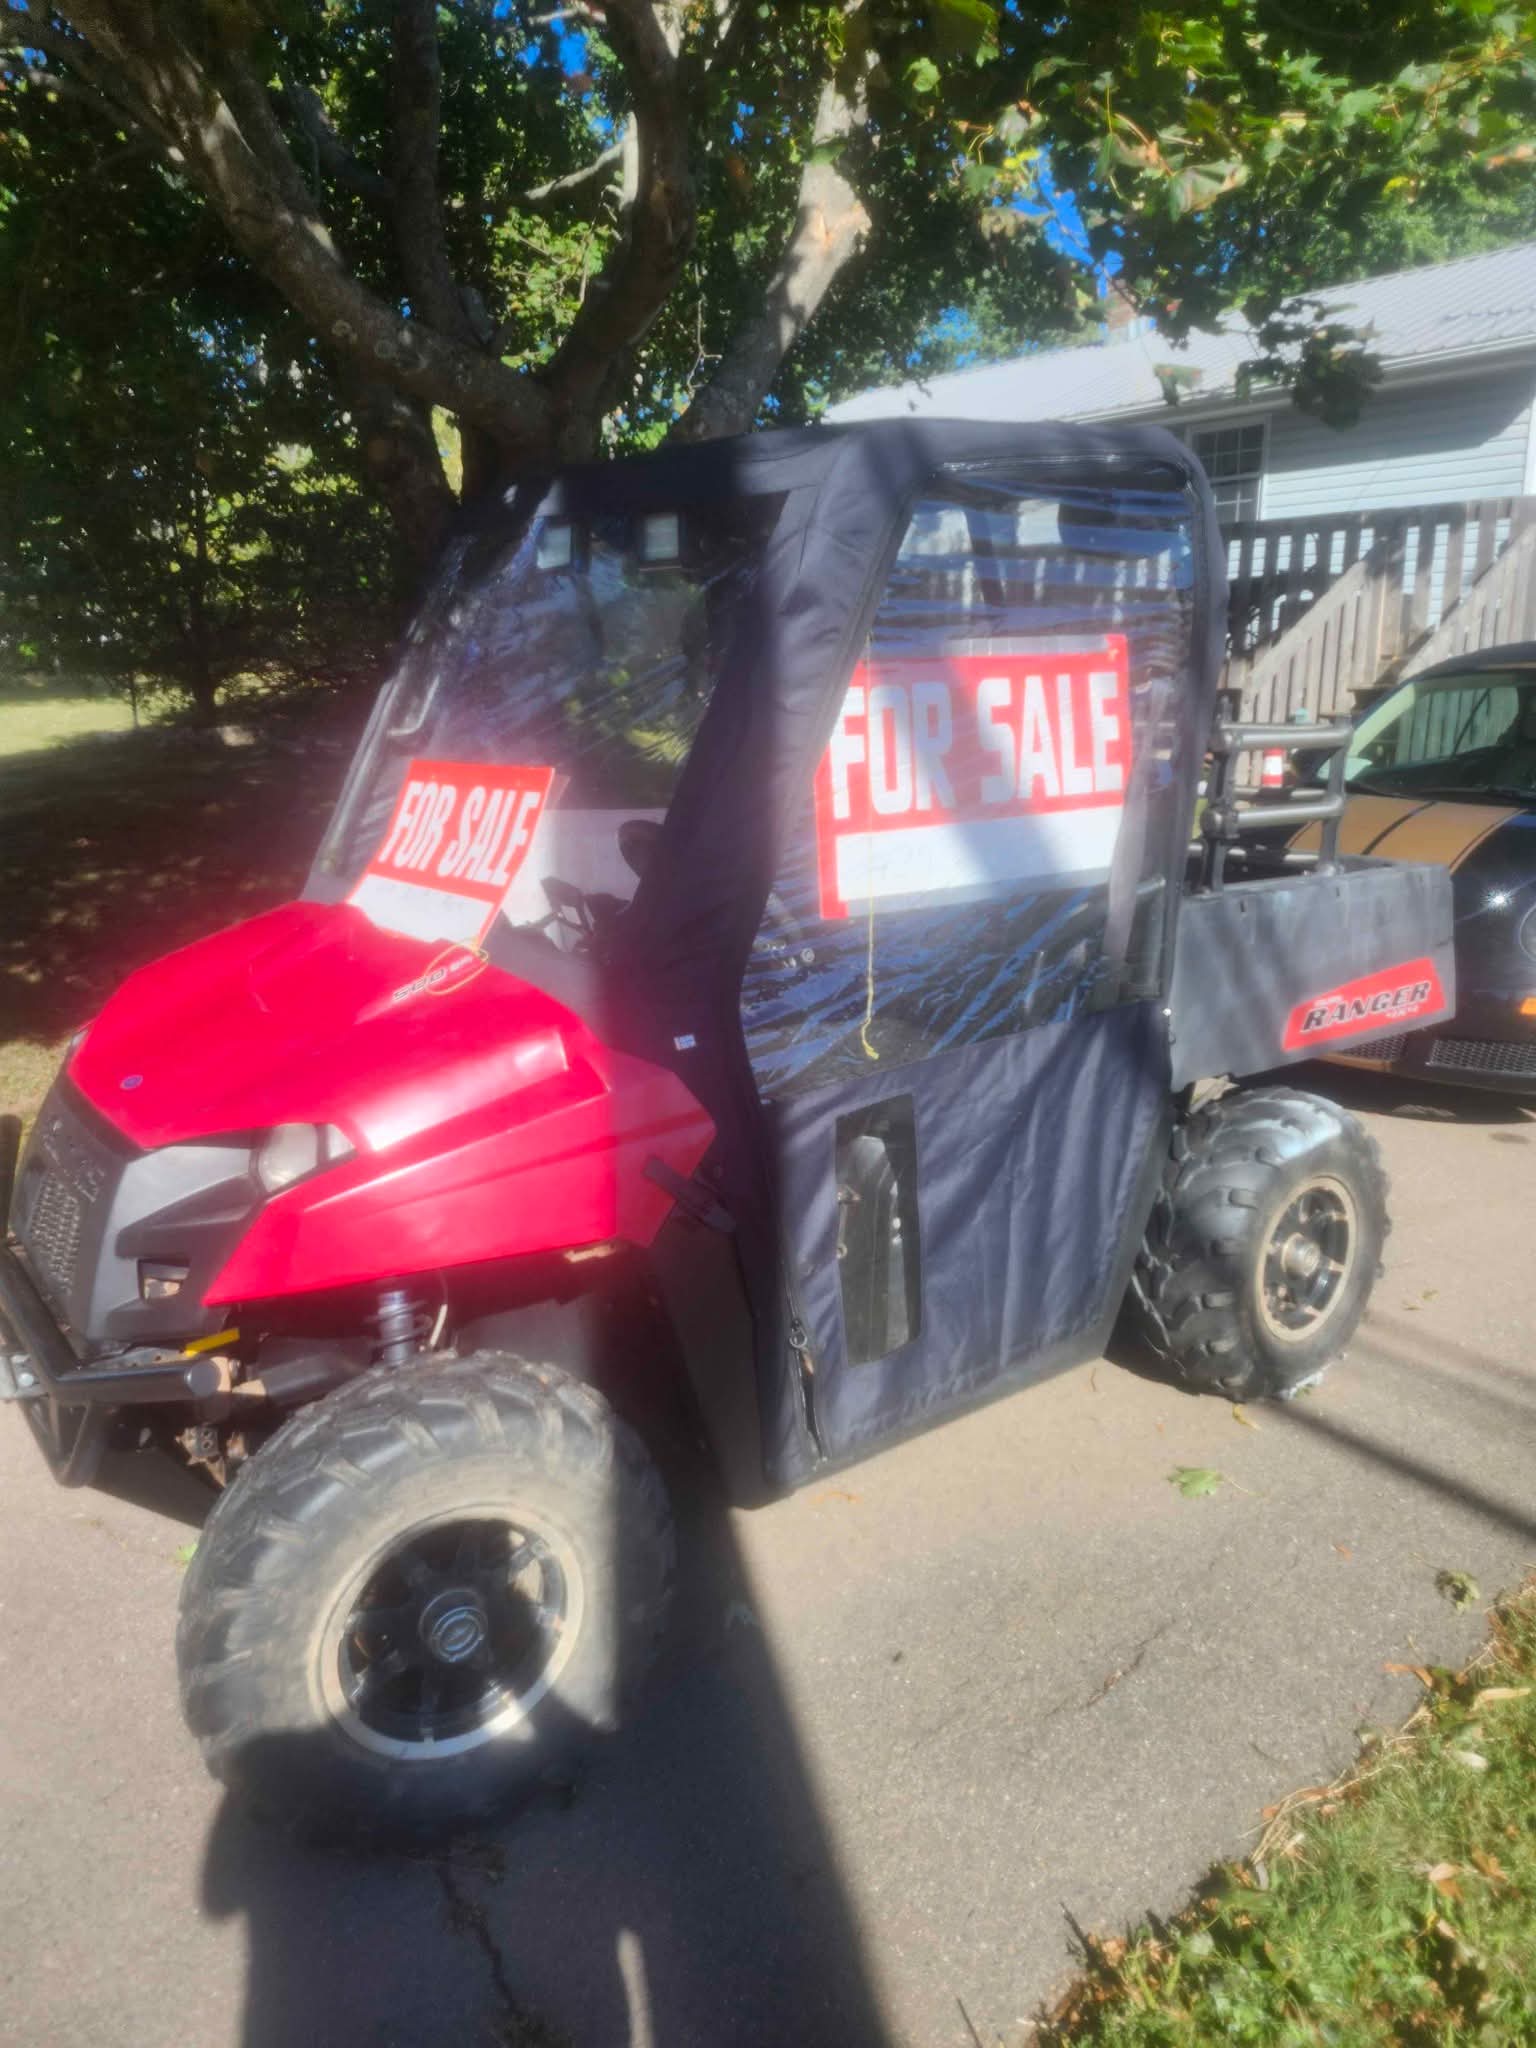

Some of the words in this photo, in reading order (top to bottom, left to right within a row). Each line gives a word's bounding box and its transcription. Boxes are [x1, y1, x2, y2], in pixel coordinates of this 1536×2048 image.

[830, 681, 956, 820] FOR
[976, 671, 1123, 805] SALE
[378, 780, 457, 872] FOR
[436, 786, 541, 887] SALE
[1300, 979, 1432, 1034] RANGER
